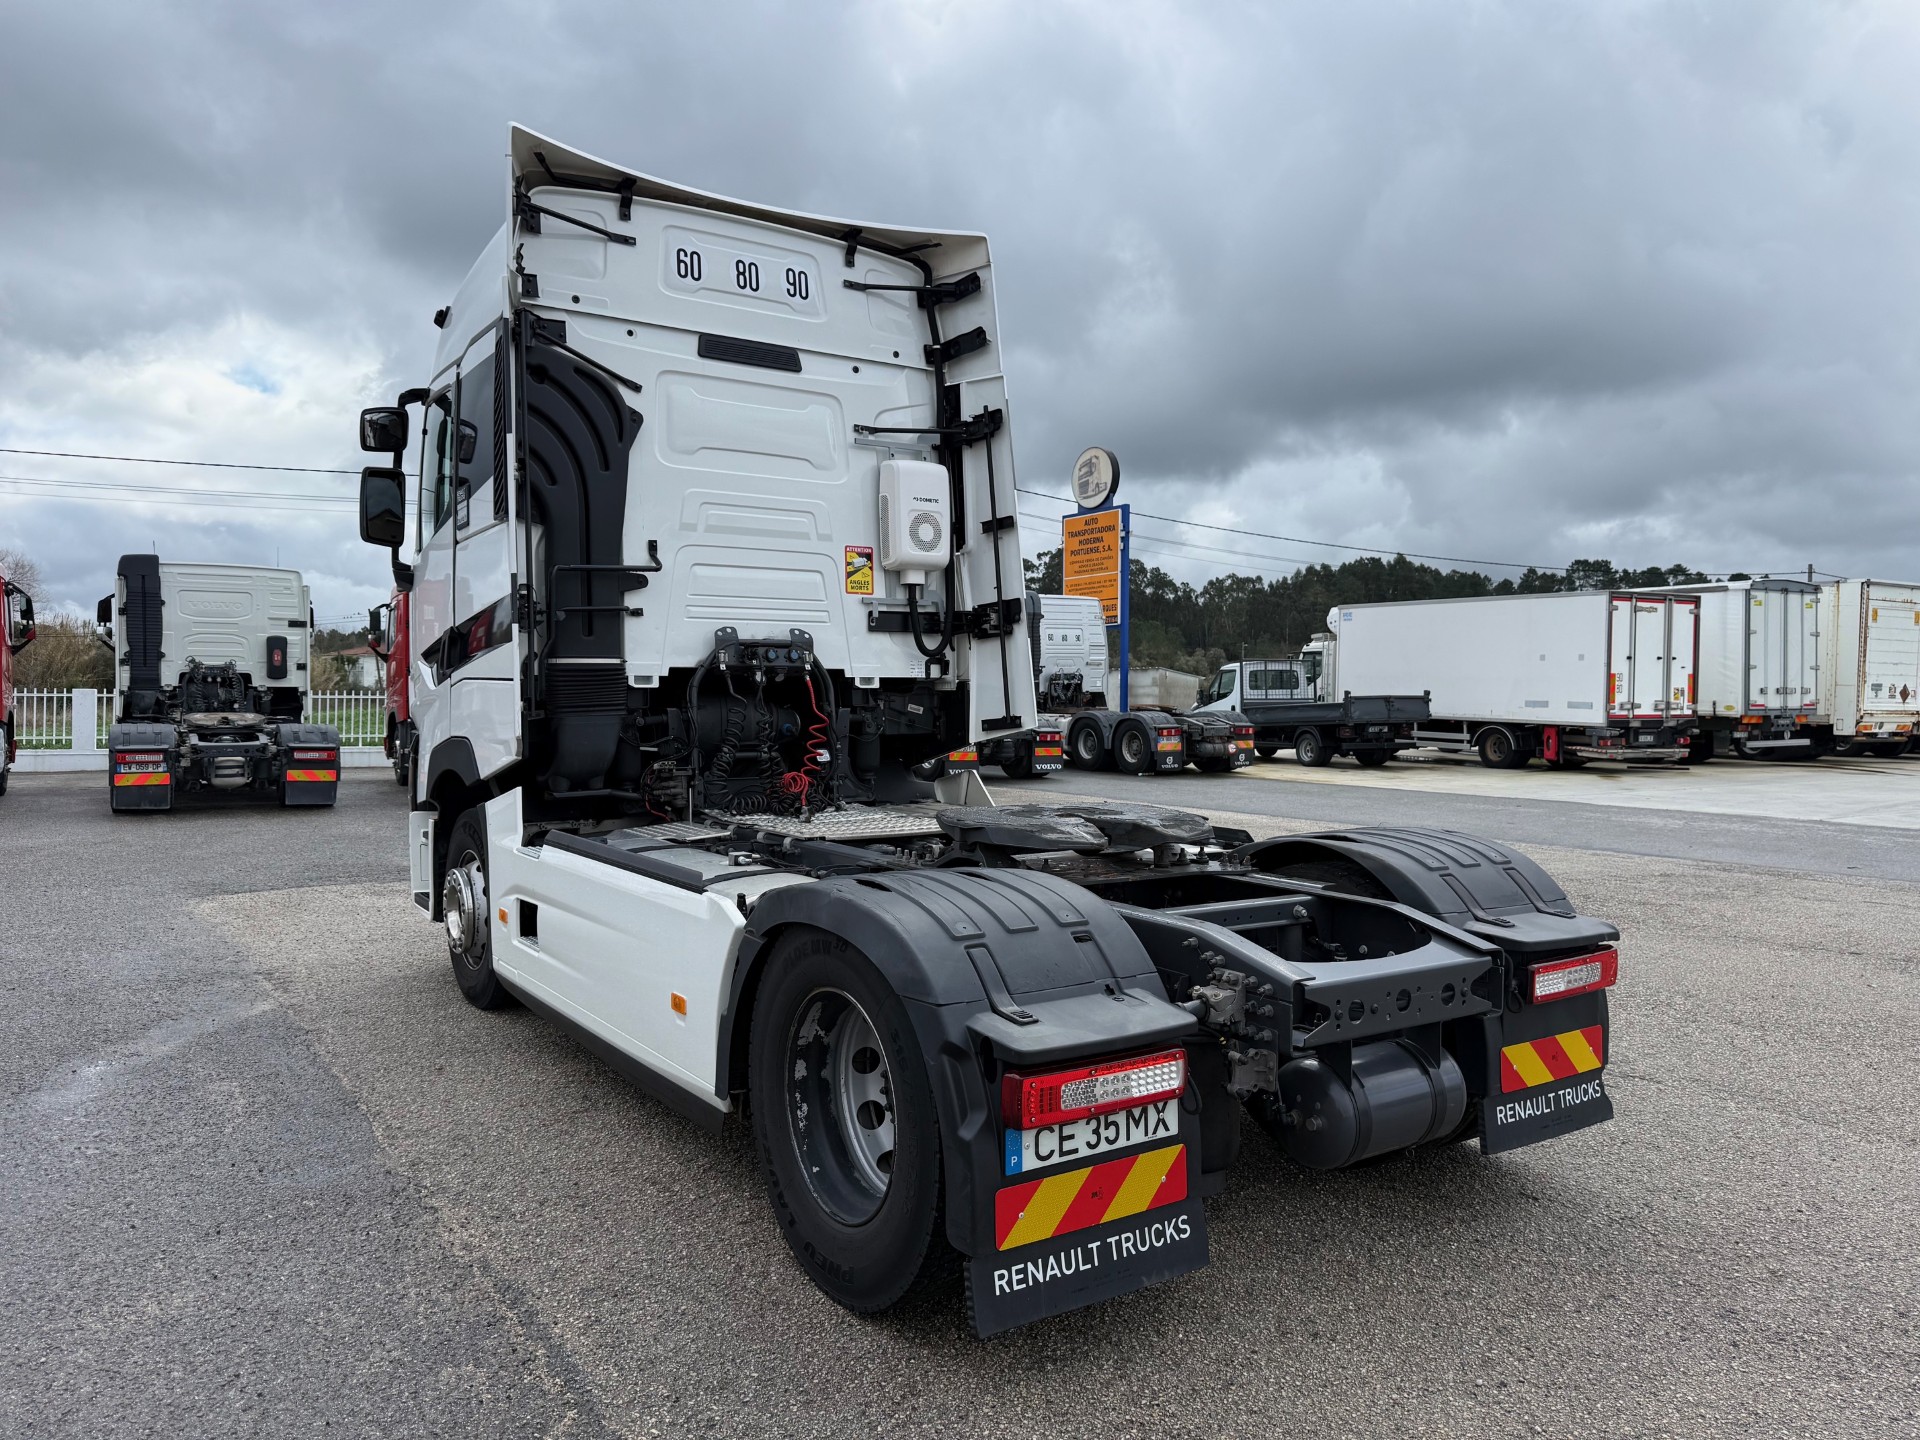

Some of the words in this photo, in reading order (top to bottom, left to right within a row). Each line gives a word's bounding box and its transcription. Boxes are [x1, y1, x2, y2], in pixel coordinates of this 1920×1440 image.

[676, 247, 702, 282] 60
[735, 259, 760, 292] 80
[785, 267, 809, 301] 90
[1083, 517, 1099, 526] AUTO
[1067, 524, 1116, 539] TRANSPORTADORA
[1078, 536, 1104, 547] MODERNA
[1070, 545, 1102, 557] PORTUENSE,
[1102, 544, 1113, 553] S.A.
[187, 600, 243, 611] VOLVO
[1047, 633, 1054, 642] 60
[1496, 1092, 1556, 1126] RENAULT
[1557, 1079, 1602, 1109] TRUCKS
[1011, 1156, 1018, 1167] P
[993, 1240, 1101, 1296] RENAULT
[1106, 1214, 1191, 1261] TRUCKS
